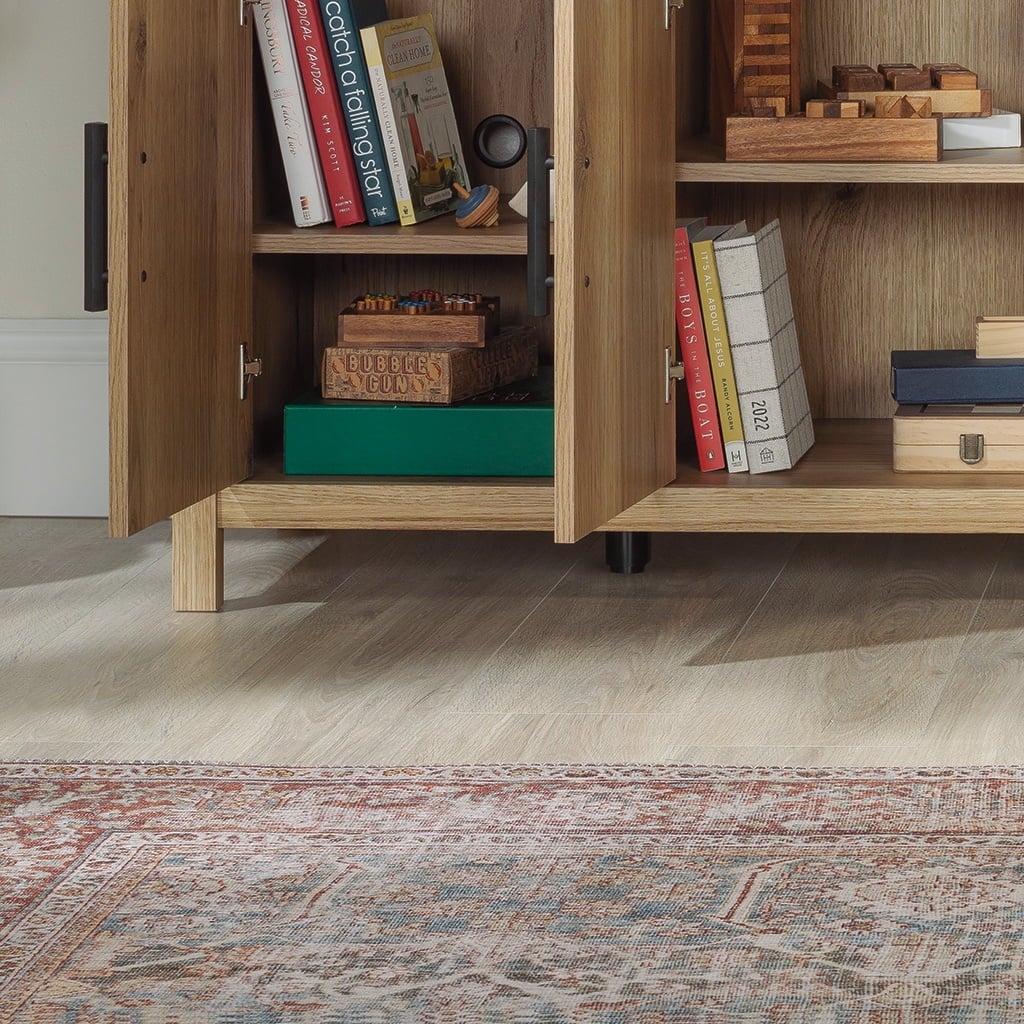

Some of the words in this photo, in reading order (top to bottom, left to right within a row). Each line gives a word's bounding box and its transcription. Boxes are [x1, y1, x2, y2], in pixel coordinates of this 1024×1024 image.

[325, 0, 356, 67] catch
[306, 45, 326, 95] CANDOR
[387, 51, 408, 66] CLEAN
[409, 45, 431, 61] HOME
[343, 70, 357, 86] a
[321, 114, 332, 134] KIM
[346, 88, 374, 156] falling
[326, 140, 340, 172] SCOTT
[385, 120, 395, 145] CLEAN
[390, 144, 400, 168] HOME
[360, 159, 383, 198] star
[700, 251, 710, 271] IT'S
[678, 271, 687, 287] THE
[704, 274, 713, 294] ALL
[678, 293, 698, 344] BOYS
[707, 298, 720, 333] ABOUT
[345, 354, 427, 375] BUBBLE
[691, 350, 698, 362] IN
[713, 337, 726, 368] JESUS
[694, 367, 702, 384] THE
[721, 378, 731, 402] RANDY
[694, 389, 714, 440] BOAT
[725, 403, 735, 431] ALCORN
[752, 400, 770, 432] 2022
